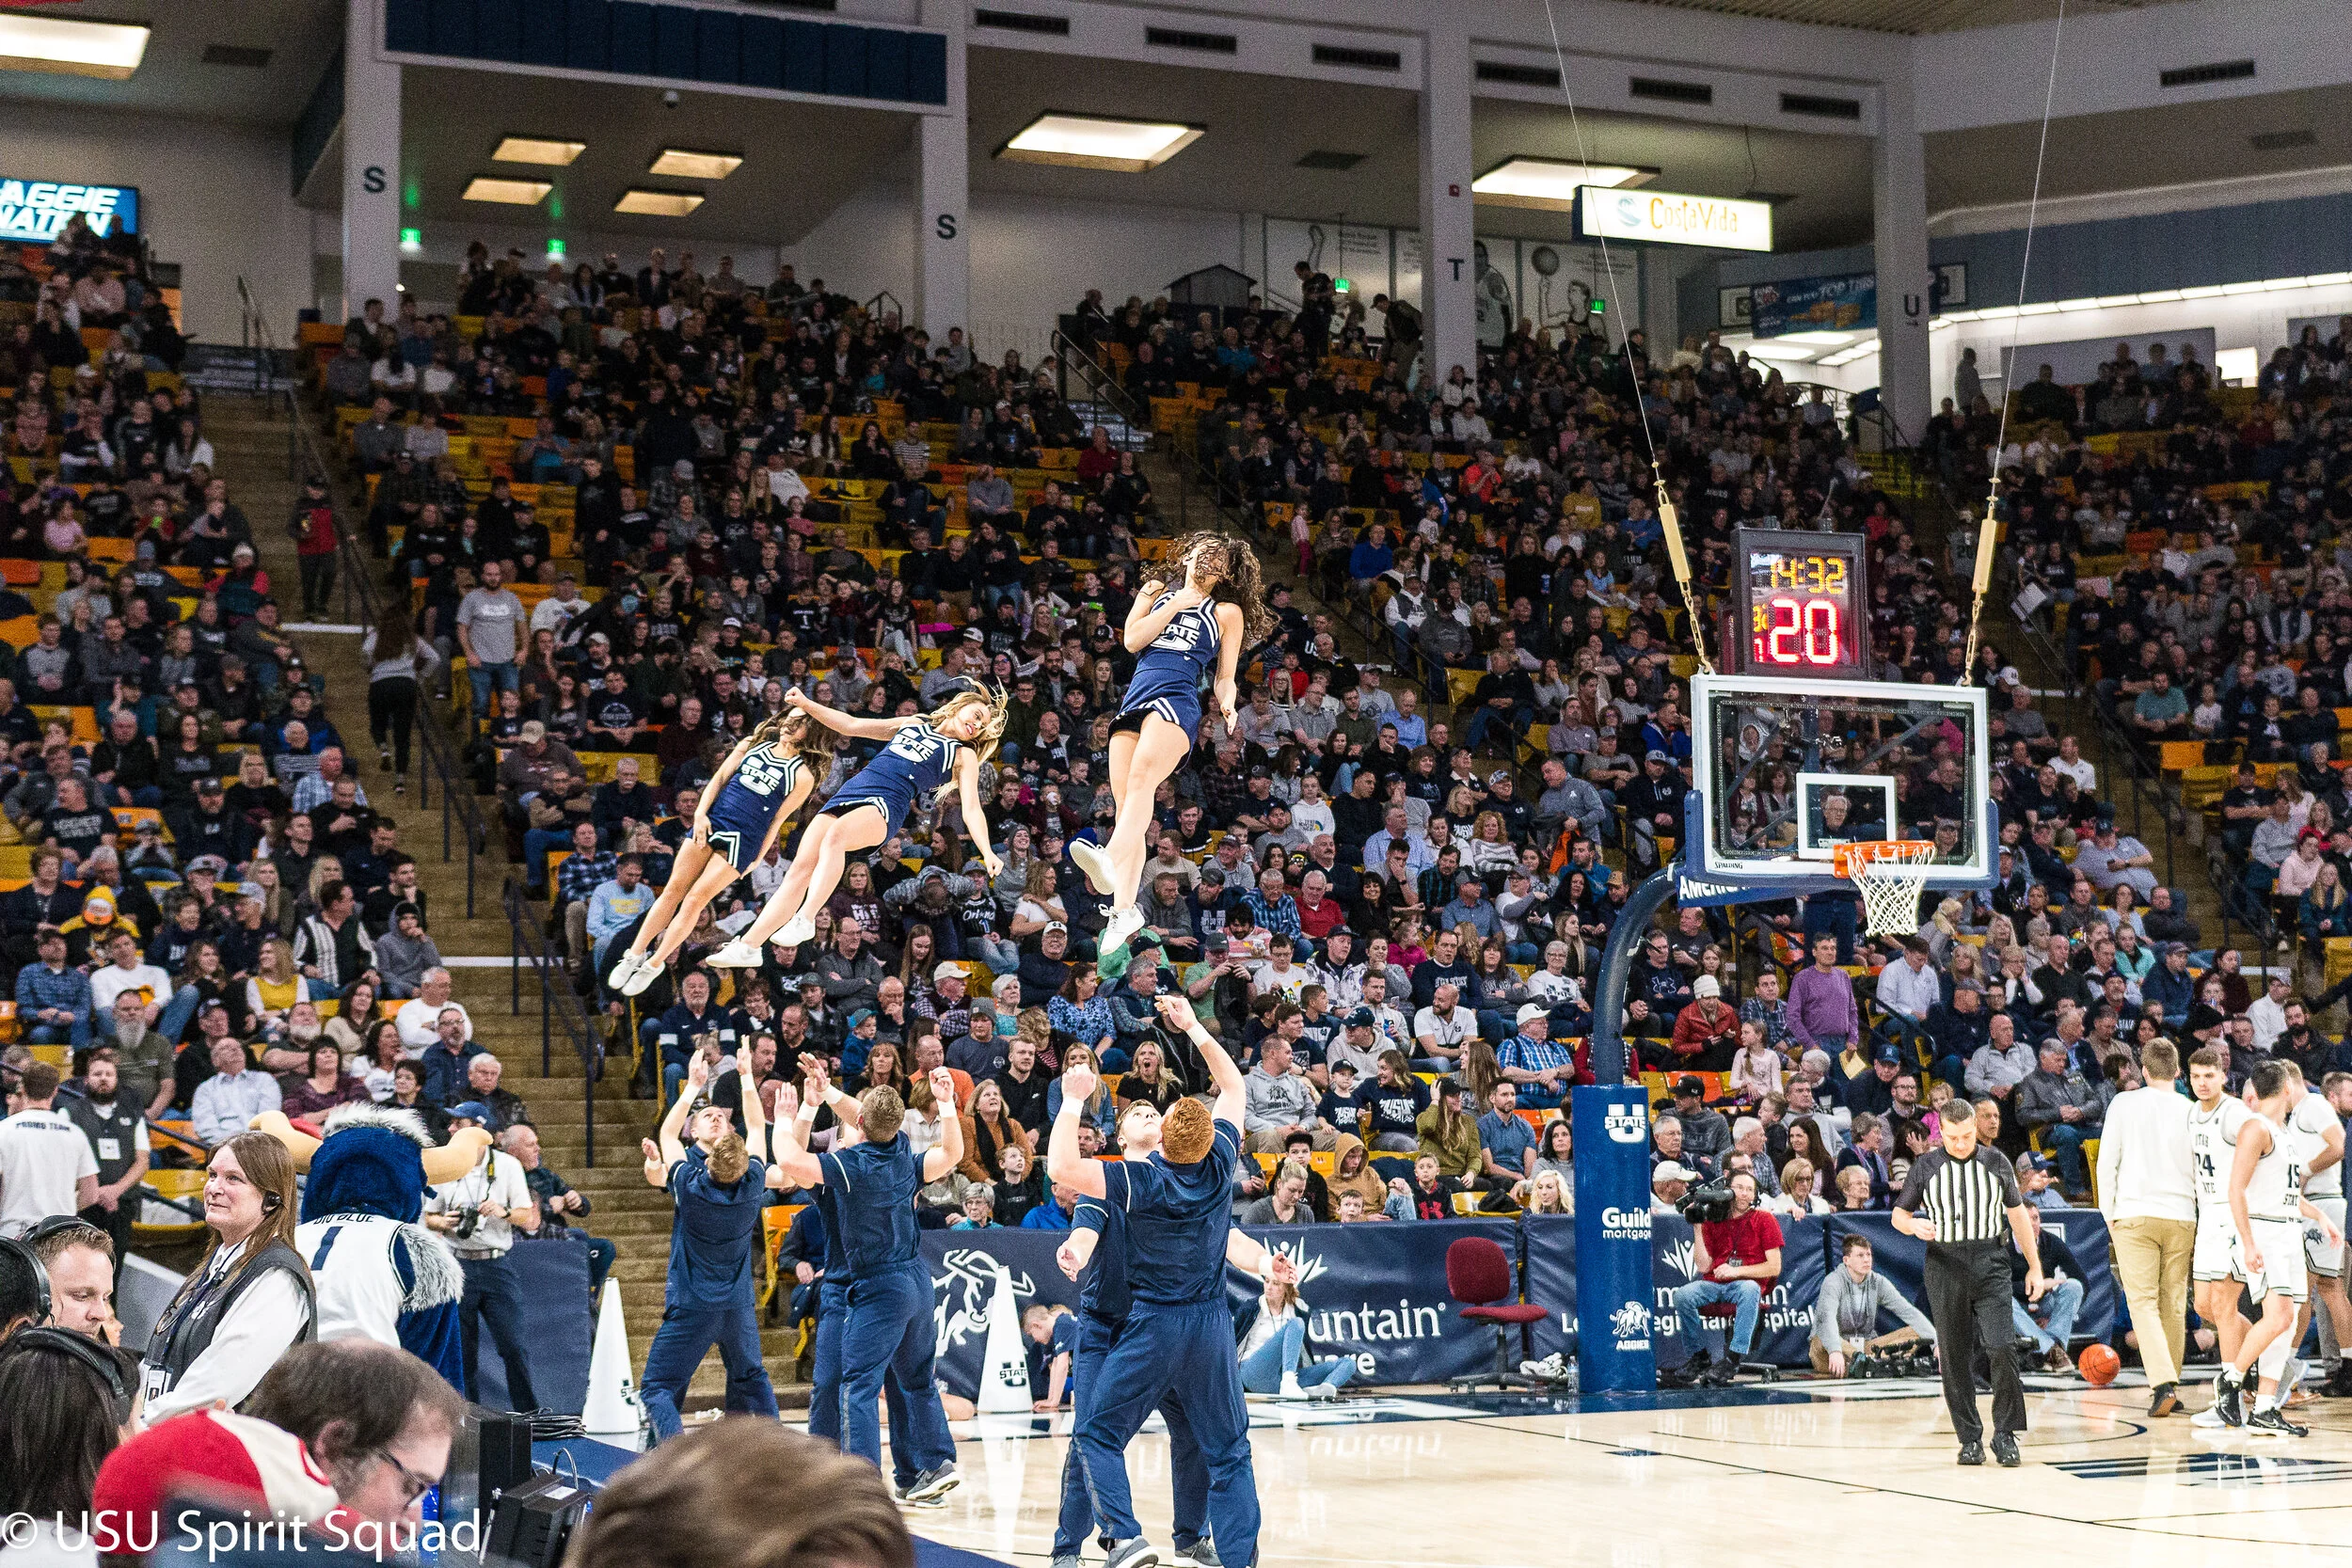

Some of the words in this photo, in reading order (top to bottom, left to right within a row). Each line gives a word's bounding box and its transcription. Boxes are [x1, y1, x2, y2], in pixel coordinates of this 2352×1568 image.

[364, 166, 386, 193] S
[0, 179, 120, 214] AGGIE
[0, 205, 112, 238] NATIN
[937, 214, 957, 240] S
[1447, 258, 1465, 282] T
[1904, 293, 1920, 317] U
[1770, 556, 1845, 594] 14:32
[1162, 623, 1200, 646] ATE
[1769, 597, 1840, 665] 20
[741, 764, 781, 791] STATE
[1714, 861, 1743, 869] SPALDING
[1604, 1116, 1645, 1129] STATE
[1601, 1206, 1651, 1228] Guild
[310, 1226, 343, 1271] 1
